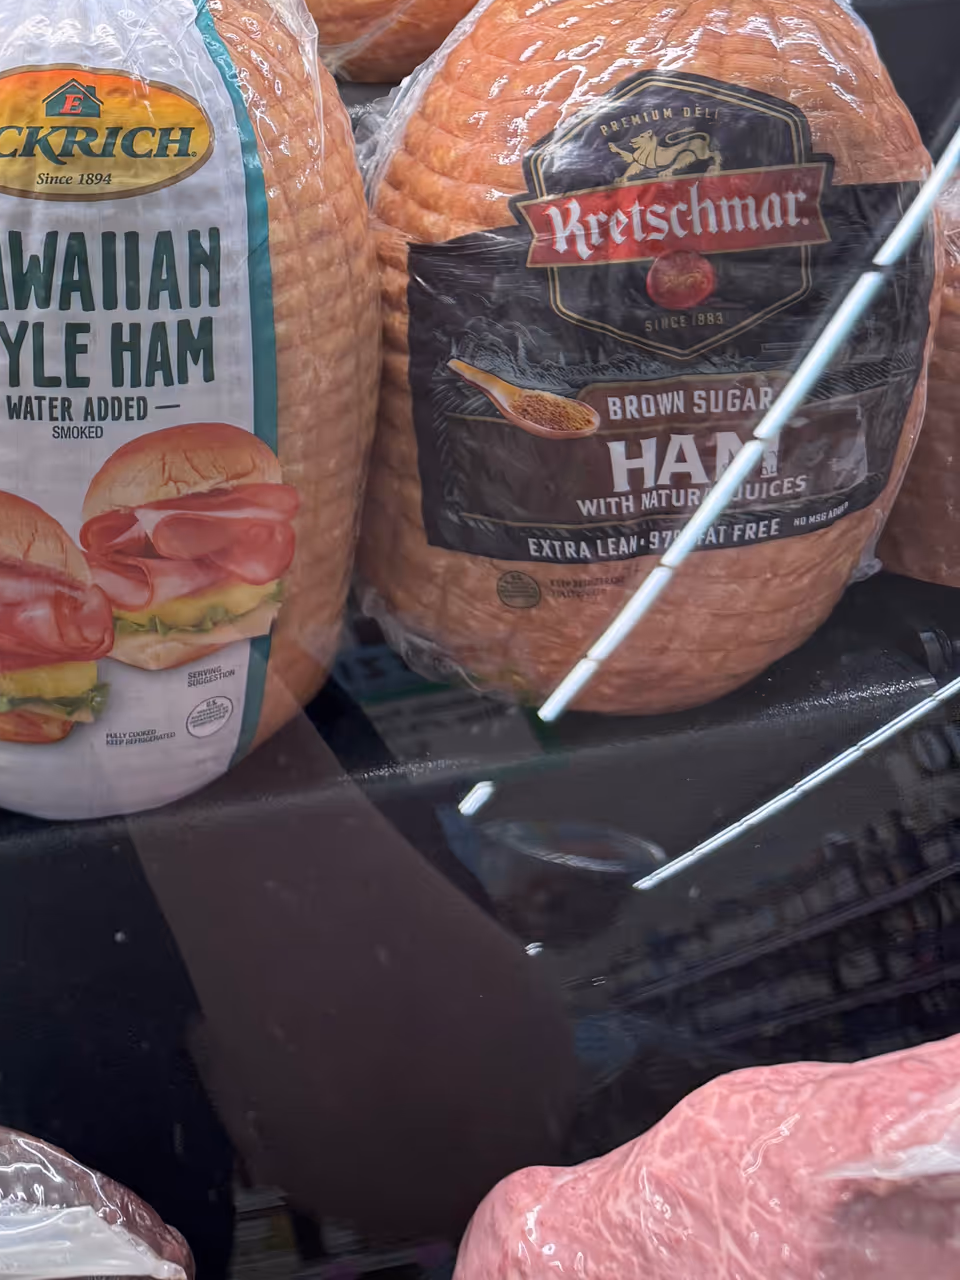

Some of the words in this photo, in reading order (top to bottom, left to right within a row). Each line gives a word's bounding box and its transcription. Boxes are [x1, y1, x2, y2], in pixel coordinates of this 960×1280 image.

[600, 107, 673, 136] PREMIUM
[683, 104, 719, 119] DELI
[37, 173, 73, 187] Since
[77, 172, 112, 185] 1894
[545, 181, 807, 260] Kretschmar
[644, 315, 687, 332] SINCE
[110, 316, 215, 388] HAM
[7, 395, 72, 421] WATER
[84, 396, 148, 421] ADDED
[607, 390, 685, 420] BROWN
[693, 387, 773, 414] SUGAR
[52, 426, 103, 439] SMOKED
[576, 496, 634, 517] WITH
[641, 488, 714, 511] NATUR
[793, 518, 806, 526] NO
[808, 512, 826, 524] MSG
[528, 537, 591, 559] EXTRA
[597, 533, 639, 557] LEAN
[733, 518, 781, 541] FREE
[188, 669, 235, 687] SUGGESTION
